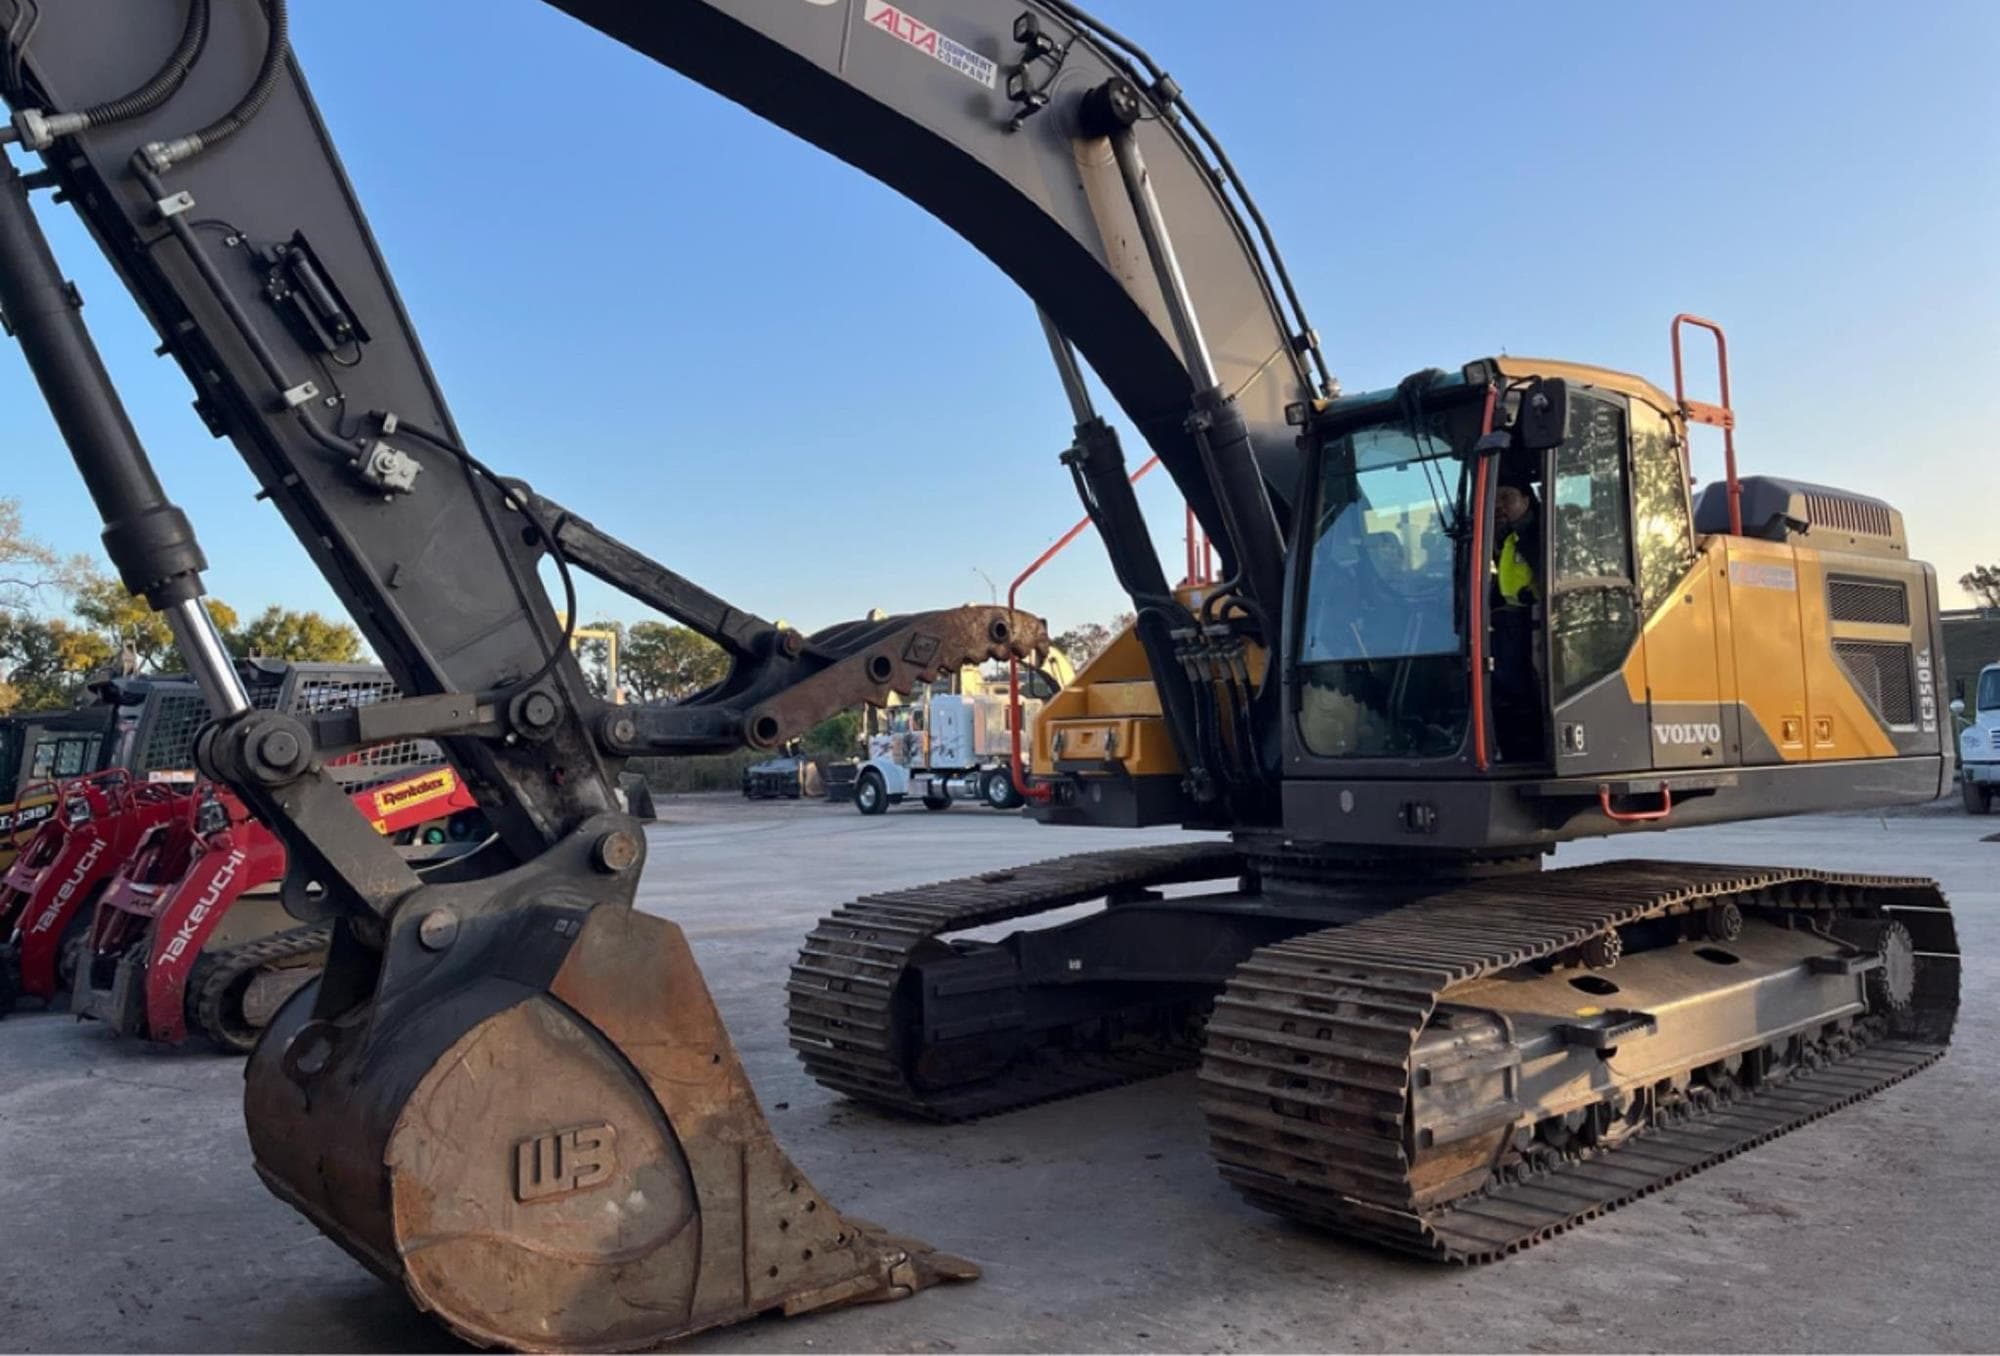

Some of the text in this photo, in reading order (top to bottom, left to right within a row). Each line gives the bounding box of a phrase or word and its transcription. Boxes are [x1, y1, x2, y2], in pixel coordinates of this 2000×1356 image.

[870, 7, 937, 55] ALTA
[937, 49, 992, 84] COMPANY
[939, 36, 993, 73] EQUIPMENT
[1654, 723, 1721, 744] VOLVO
[382, 778, 445, 805] Rentalex
[159, 849, 246, 966] TAKEUCHI
